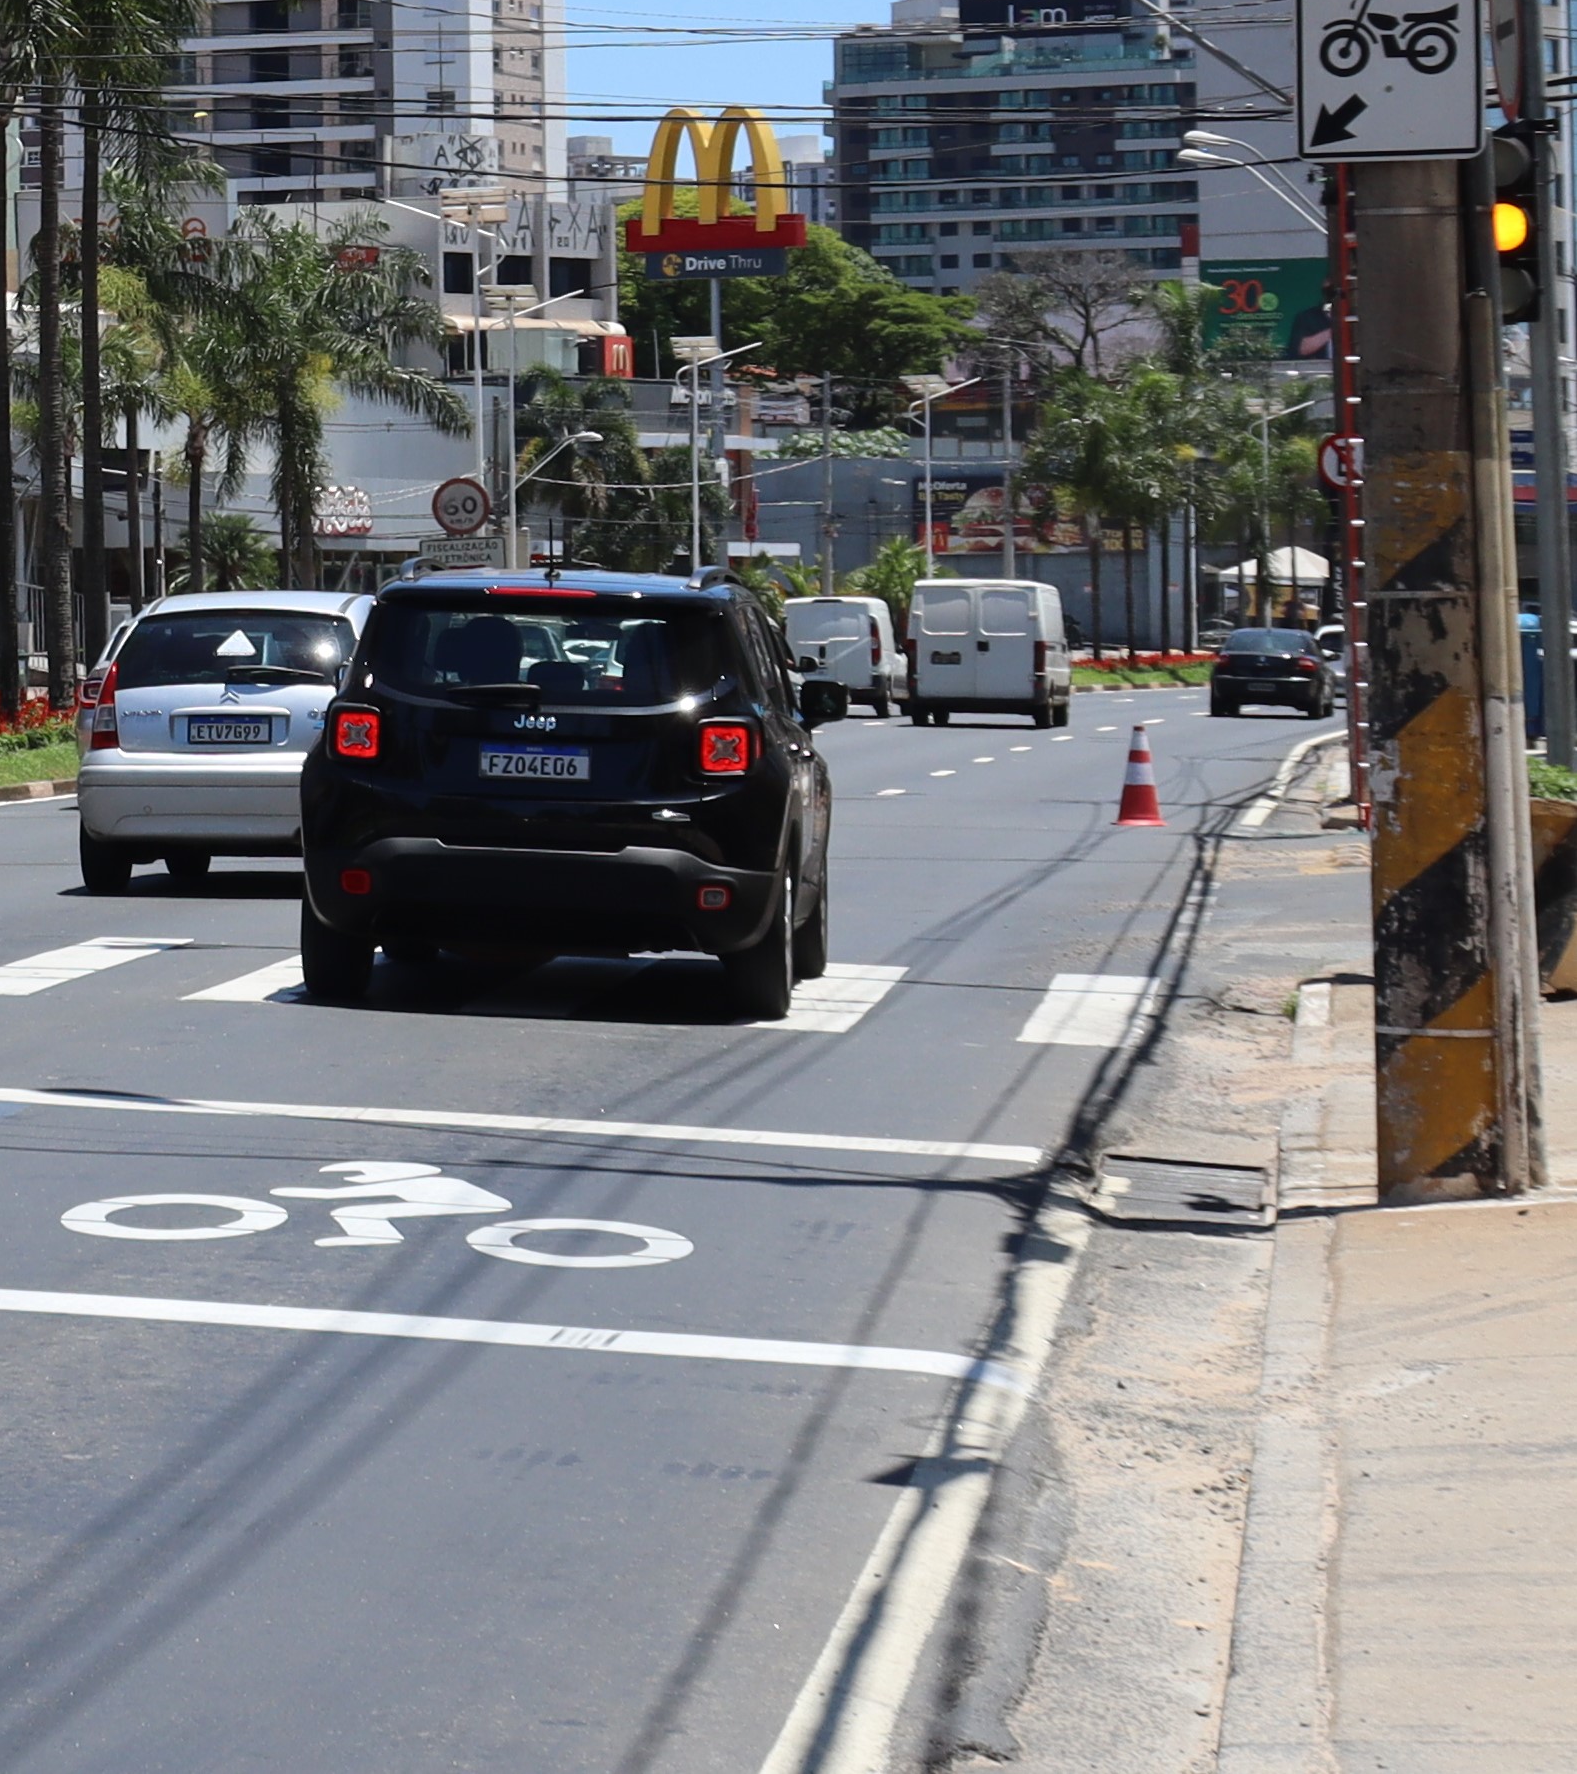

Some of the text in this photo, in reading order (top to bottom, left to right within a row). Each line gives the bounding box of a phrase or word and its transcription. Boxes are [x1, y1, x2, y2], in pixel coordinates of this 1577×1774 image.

[685, 254, 762, 271] Drive Thru
[444, 495, 478, 515] 60
[513, 714, 557, 731] Jeep
[197, 725, 261, 740] ETV7G99
